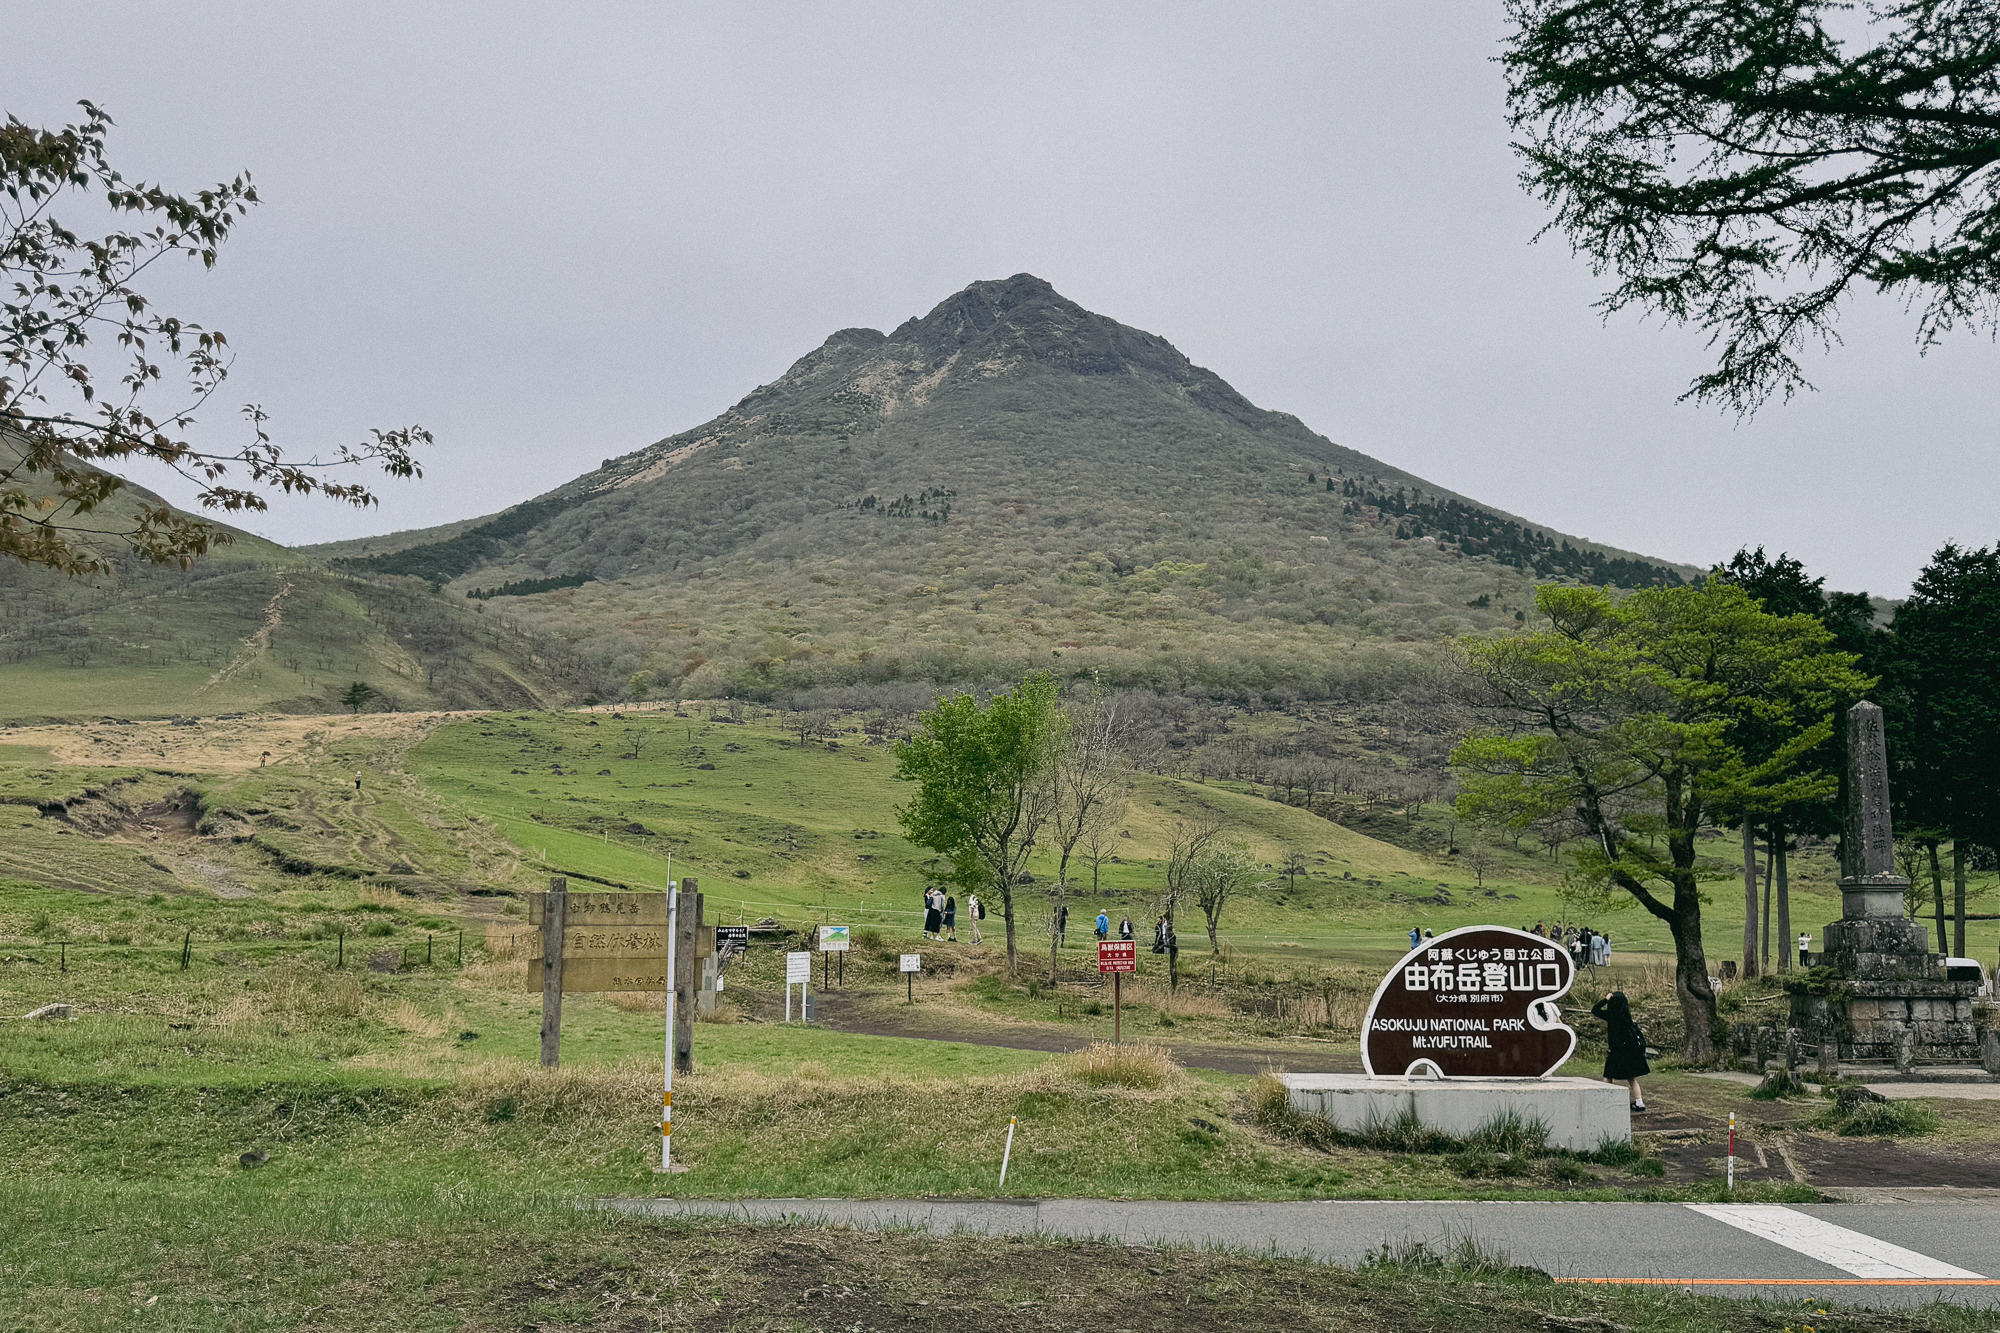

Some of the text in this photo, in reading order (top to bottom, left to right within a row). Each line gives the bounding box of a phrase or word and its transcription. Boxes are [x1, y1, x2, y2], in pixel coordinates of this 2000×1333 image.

[572, 932, 663, 951] 自然休養林
[1427, 948, 1556, 962] 阿蘇くじゅう国立公園
[1404, 962, 1561, 992] 由布岳登山口
[1371, 1018, 1526, 1032] ASOKUJU NATIONAL PARK
[1459, 1035, 1492, 1048] TRAIL
